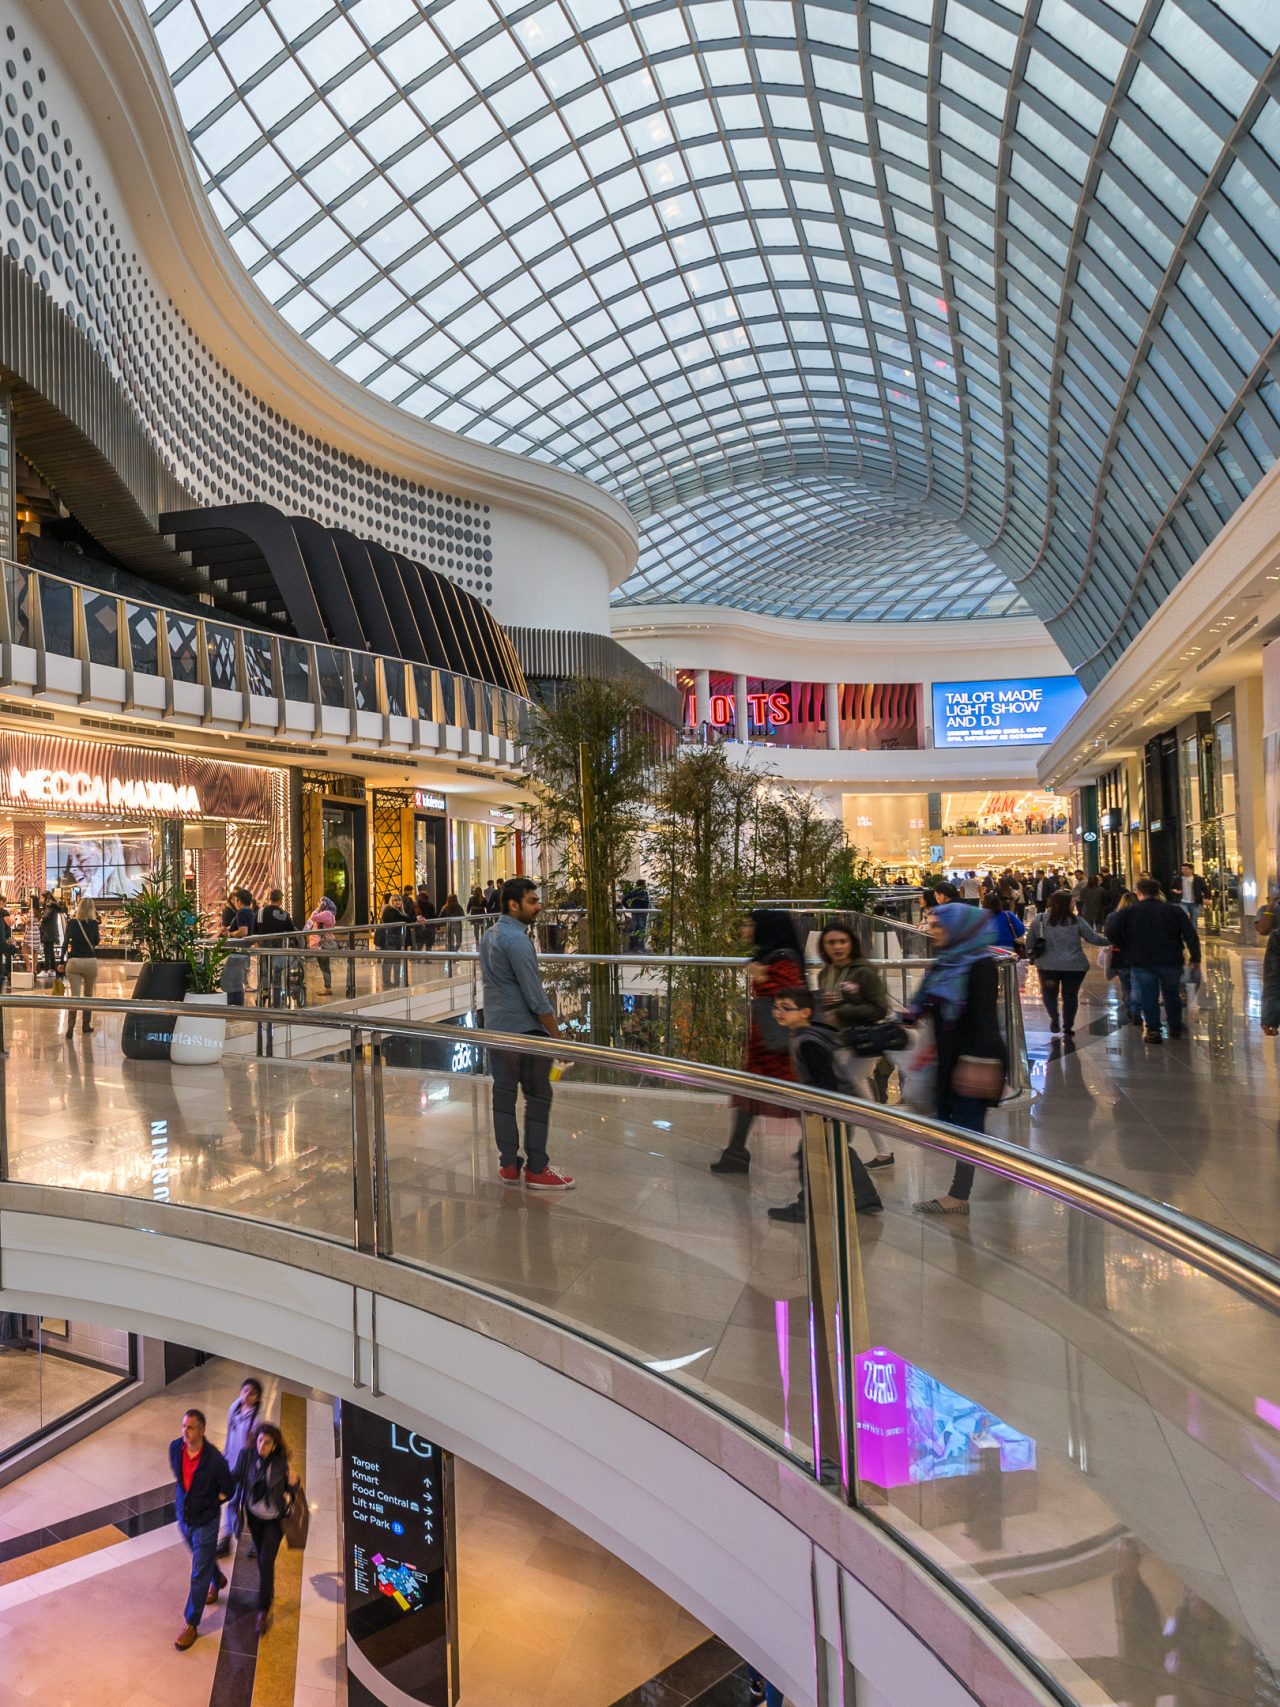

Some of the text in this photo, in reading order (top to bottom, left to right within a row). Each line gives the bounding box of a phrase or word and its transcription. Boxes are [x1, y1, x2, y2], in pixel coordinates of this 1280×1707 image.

[945, 689, 1042, 704] TAILOR MADE
[946, 701, 1040, 716] LIGHT SHOW
[946, 715, 1000, 728] AND DJ
[10, 766, 201, 812] MECCA MAXIMA
[391, 1423, 432, 1458] LG
[351, 1455, 380, 1472] Target
[351, 1469, 379, 1485] Kmart
[352, 1482, 409, 1509] Food Central
[352, 1496, 368, 1509] Lift
[352, 1510, 368, 1522] Car
[370, 1515, 391, 1531] Park
